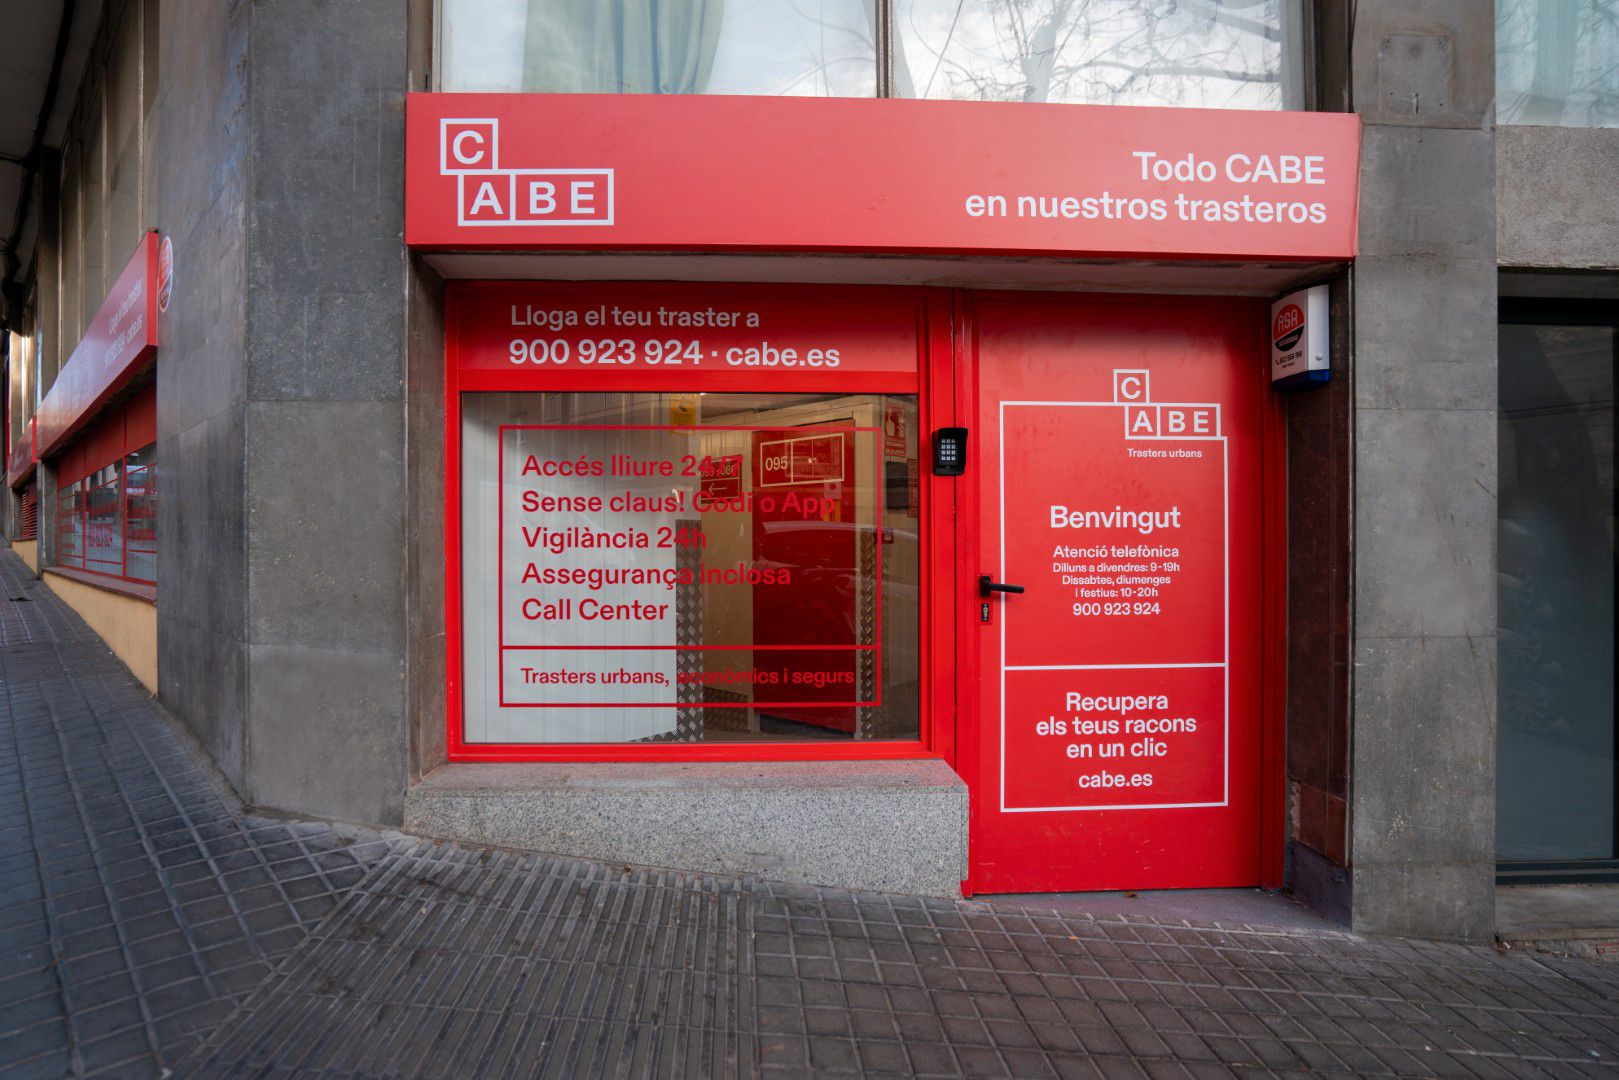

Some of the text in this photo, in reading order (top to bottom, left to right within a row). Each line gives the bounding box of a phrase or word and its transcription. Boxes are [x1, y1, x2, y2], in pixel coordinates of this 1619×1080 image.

[1133, 152, 1325, 184] Todo CABE
[966, 192, 1326, 223] en nuestros trasteros
[512, 305, 759, 331] Lloga el teu traster a
[509, 338, 570, 364] 900
[579, 340, 635, 364] 923
[645, 340, 703, 364] 924
[726, 342, 840, 367] cabe.es
[1127, 448, 1202, 457] Trasters urbans
[522, 454, 603, 476] Accés
[612, 454, 673, 476] lliure
[765, 455, 787, 472] 095
[522, 491, 835, 519] Sense claus! Codi o App
[1051, 506, 1180, 534] Benvingut
[522, 526, 707, 555] Vigilància 24h
[1054, 545, 1178, 558] Atenció telefònica
[522, 562, 791, 591] Assegurança inclosa
[1053, 563, 1086, 572] Dilluns
[1097, 563, 1148, 572] divendres:
[1063, 575, 1170, 586] Dissabtes, diumenges
[1080, 588, 1118, 597] festius:
[522, 599, 668, 621] Call Center
[1073, 602, 1160, 616] 900 923 924
[521, 668, 596, 685] Trasters
[601, 668, 669, 687] urbans,
[792, 671, 854, 689] segurs
[1066, 692, 1168, 715] Recupera
[1036, 716, 1196, 735] els teus racons
[1067, 738, 1167, 758] en un clic
[1079, 770, 1152, 787] cabe.es
